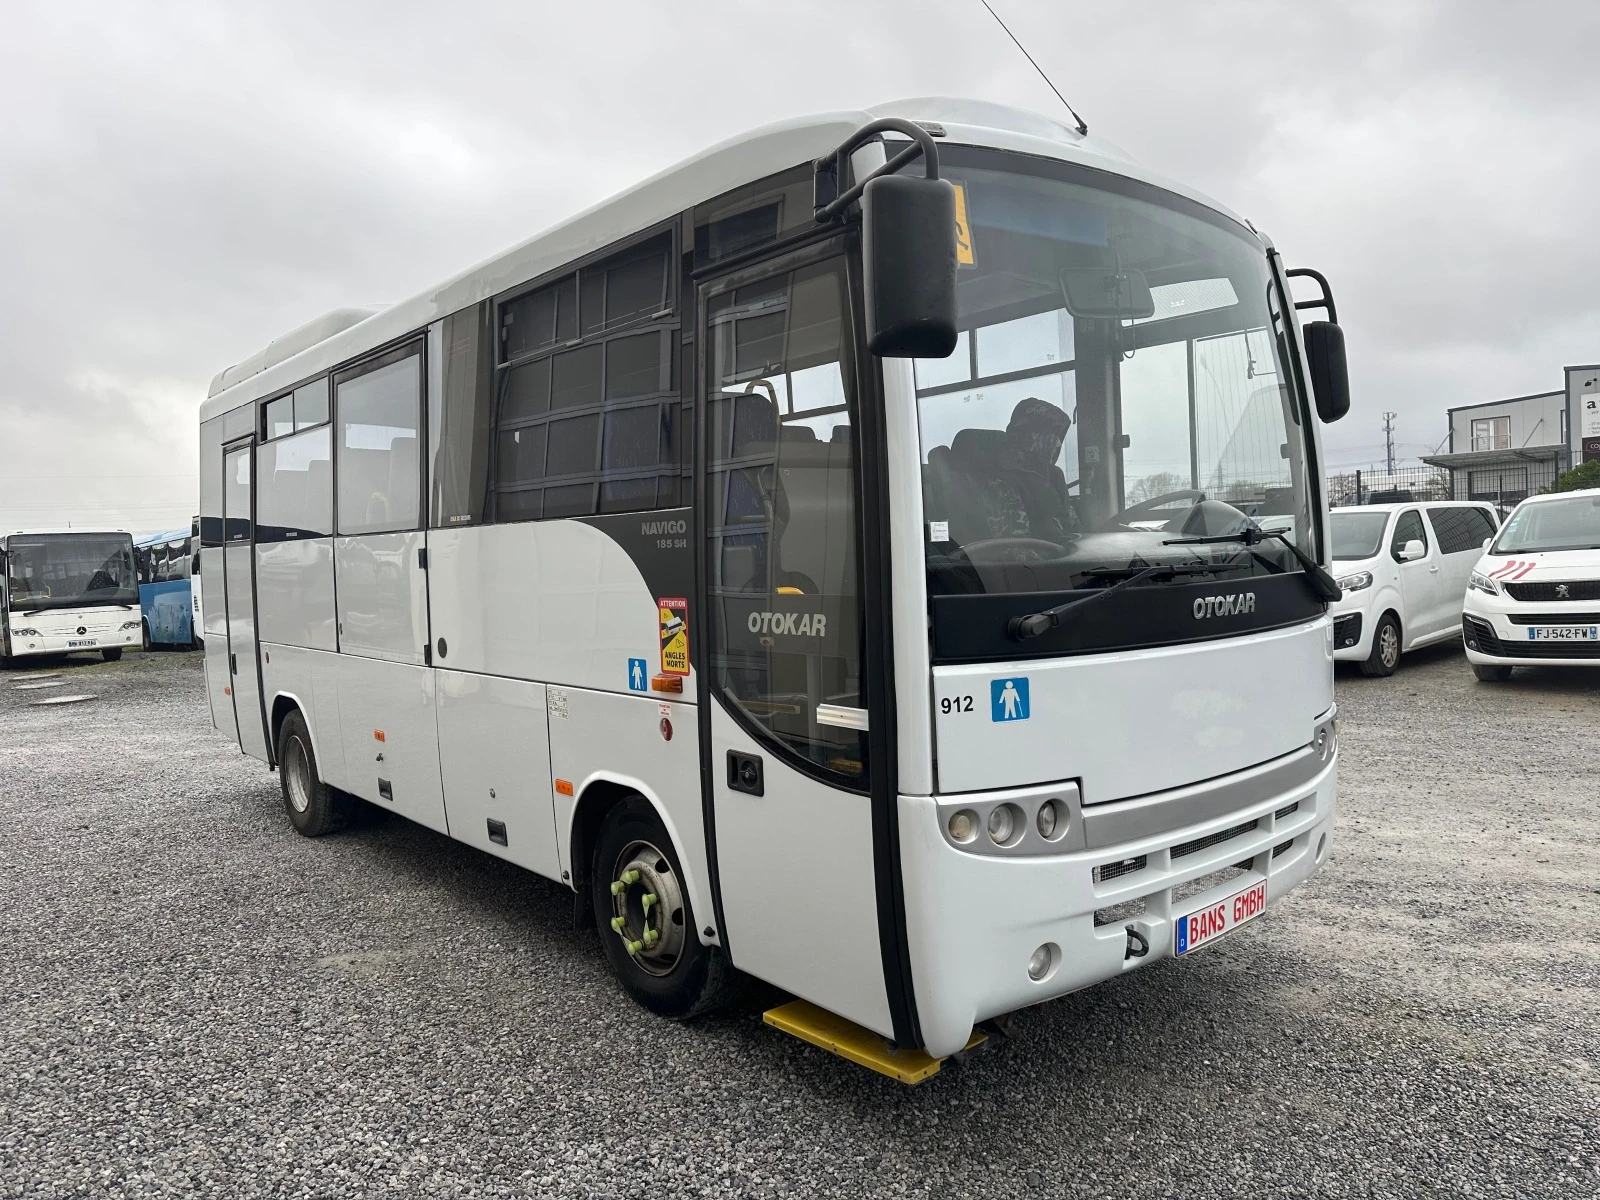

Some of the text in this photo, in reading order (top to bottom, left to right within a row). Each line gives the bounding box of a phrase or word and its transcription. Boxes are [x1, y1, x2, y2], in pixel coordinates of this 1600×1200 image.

[641, 520, 687, 535] NAVIGO
[656, 538, 687, 549] 185 SH
[660, 600, 686, 608] ATTENTION
[1193, 592, 1256, 620] OTOKAR
[747, 611, 827, 637] OTOKAR
[1536, 628, 1588, 639] FJ-542-FW
[665, 651, 686, 660] ANGLES
[666, 659, 685, 669] MORTS
[941, 695, 974, 715] 912
[1189, 904, 1226, 945] BANS
[1233, 884, 1265, 923] GMBH
